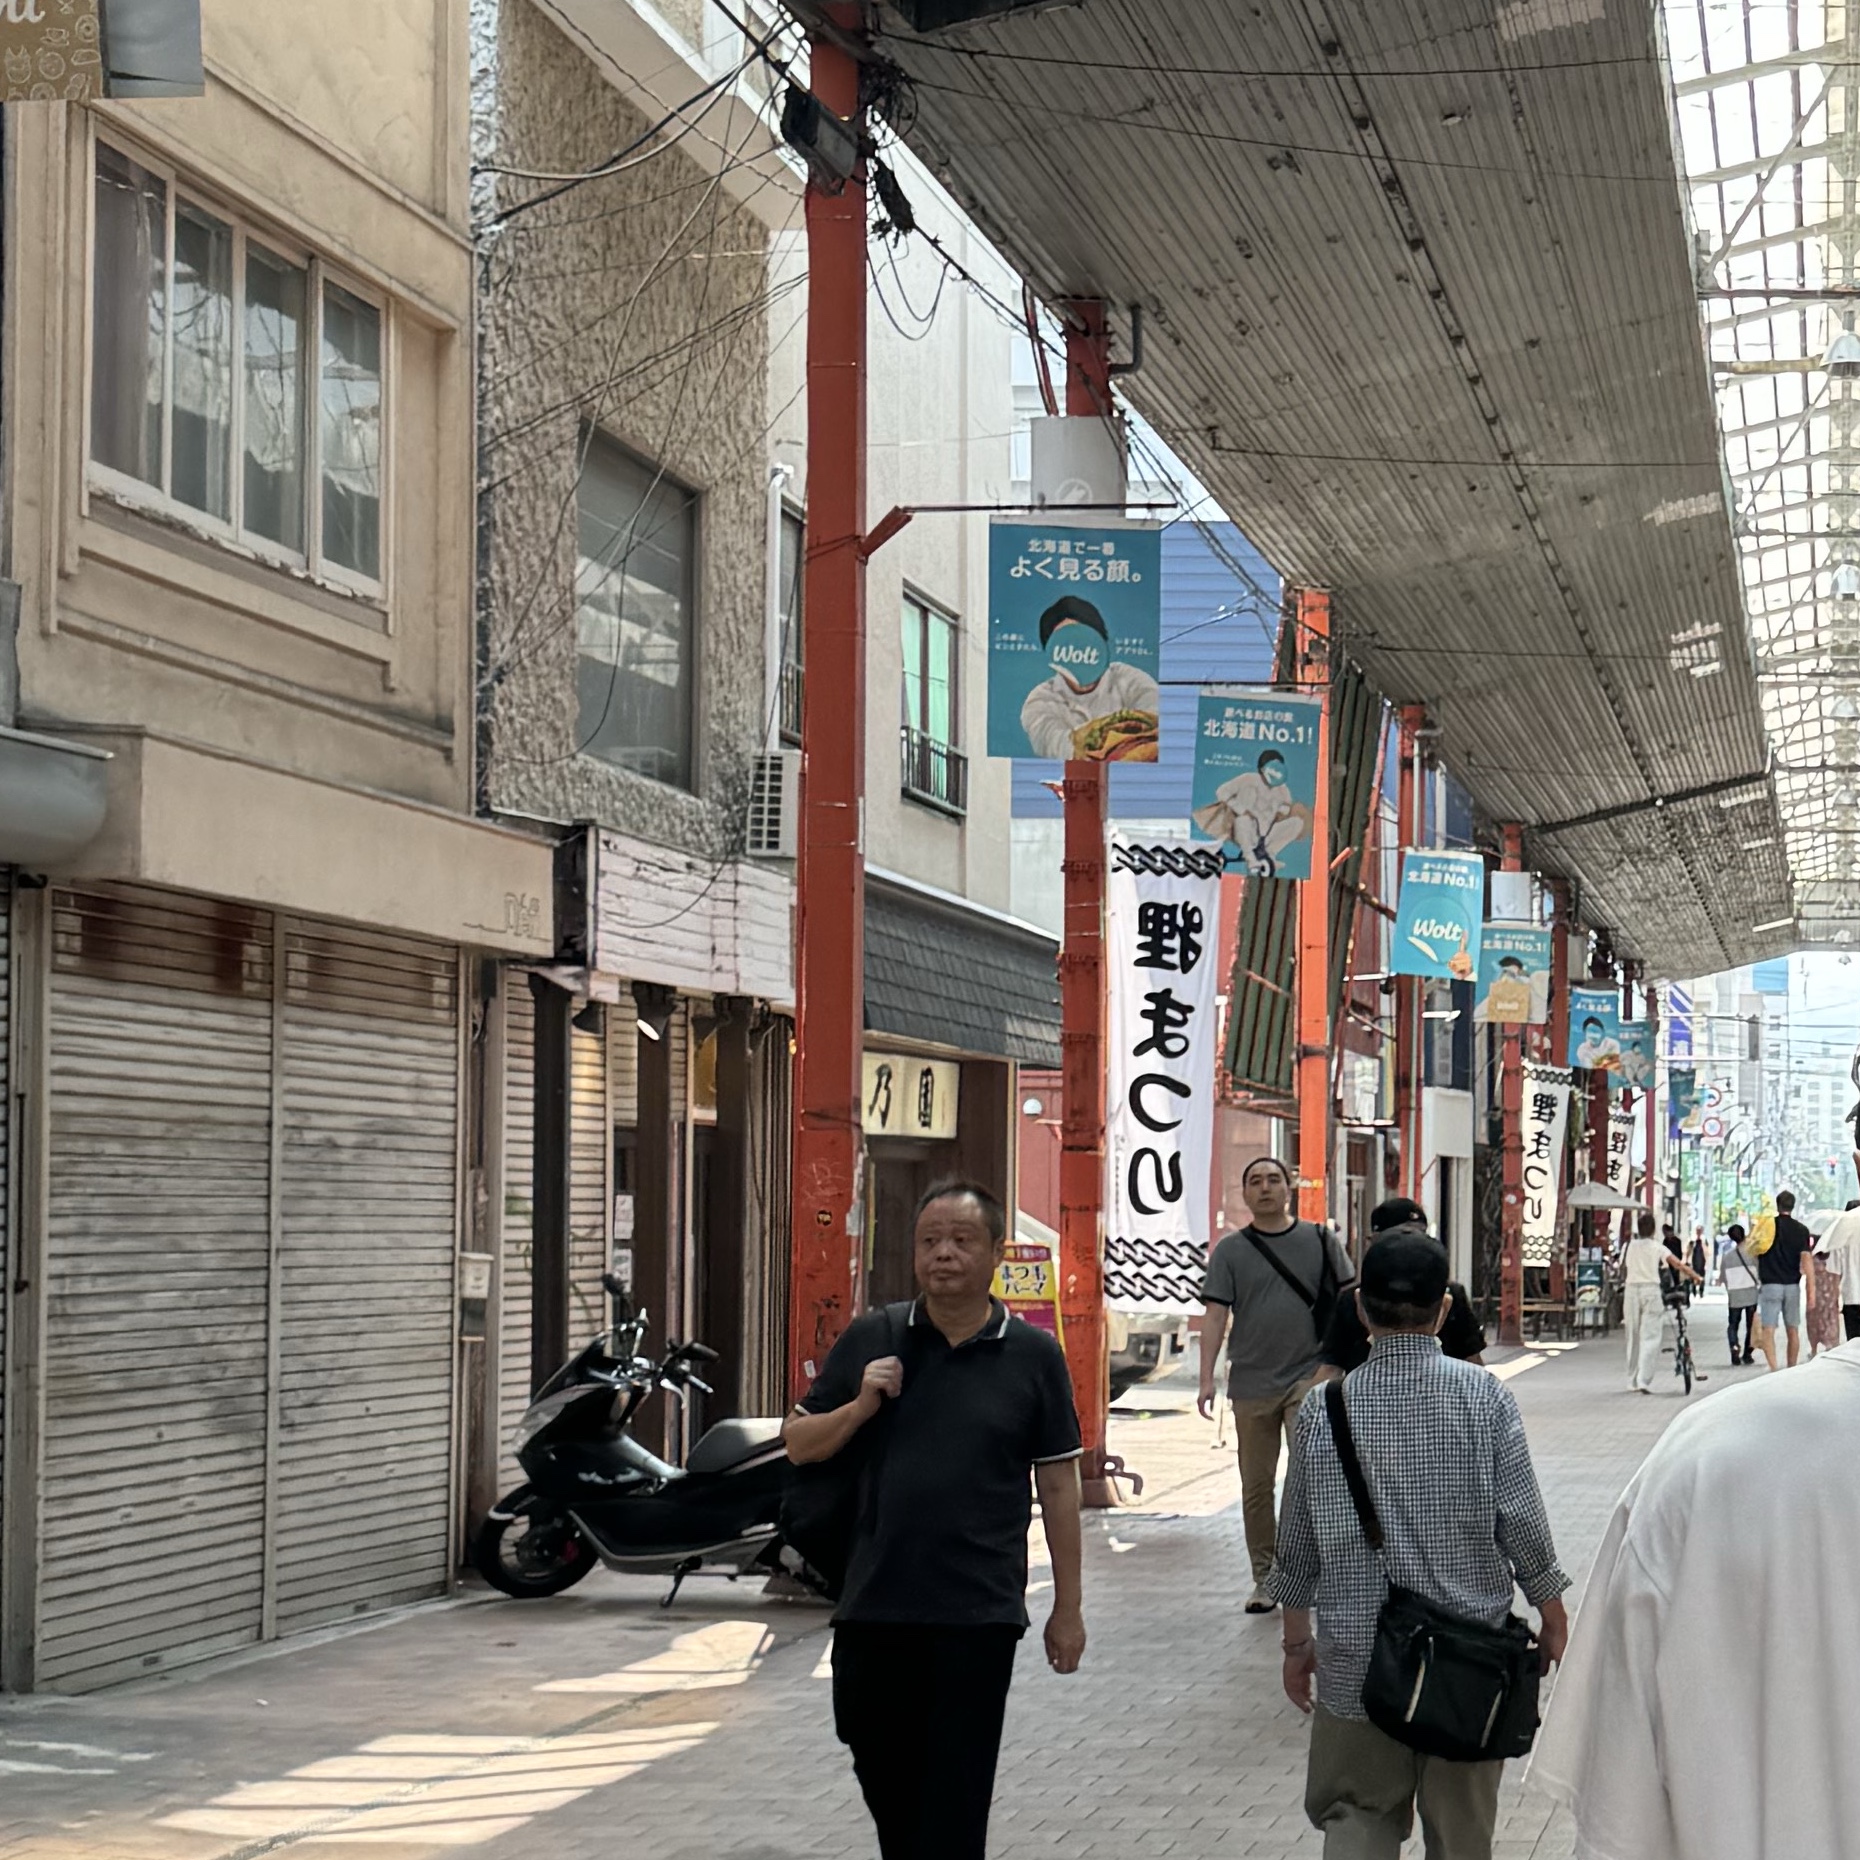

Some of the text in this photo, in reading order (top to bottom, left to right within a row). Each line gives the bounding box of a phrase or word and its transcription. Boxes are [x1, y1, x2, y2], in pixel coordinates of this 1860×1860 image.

[1010, 556, 1142, 583] よく見る顔。
[1052, 645, 1100, 665] Wolt
[1203, 717, 1314, 745] 北海道No.1!
[1413, 918, 1463, 942] Wolt
